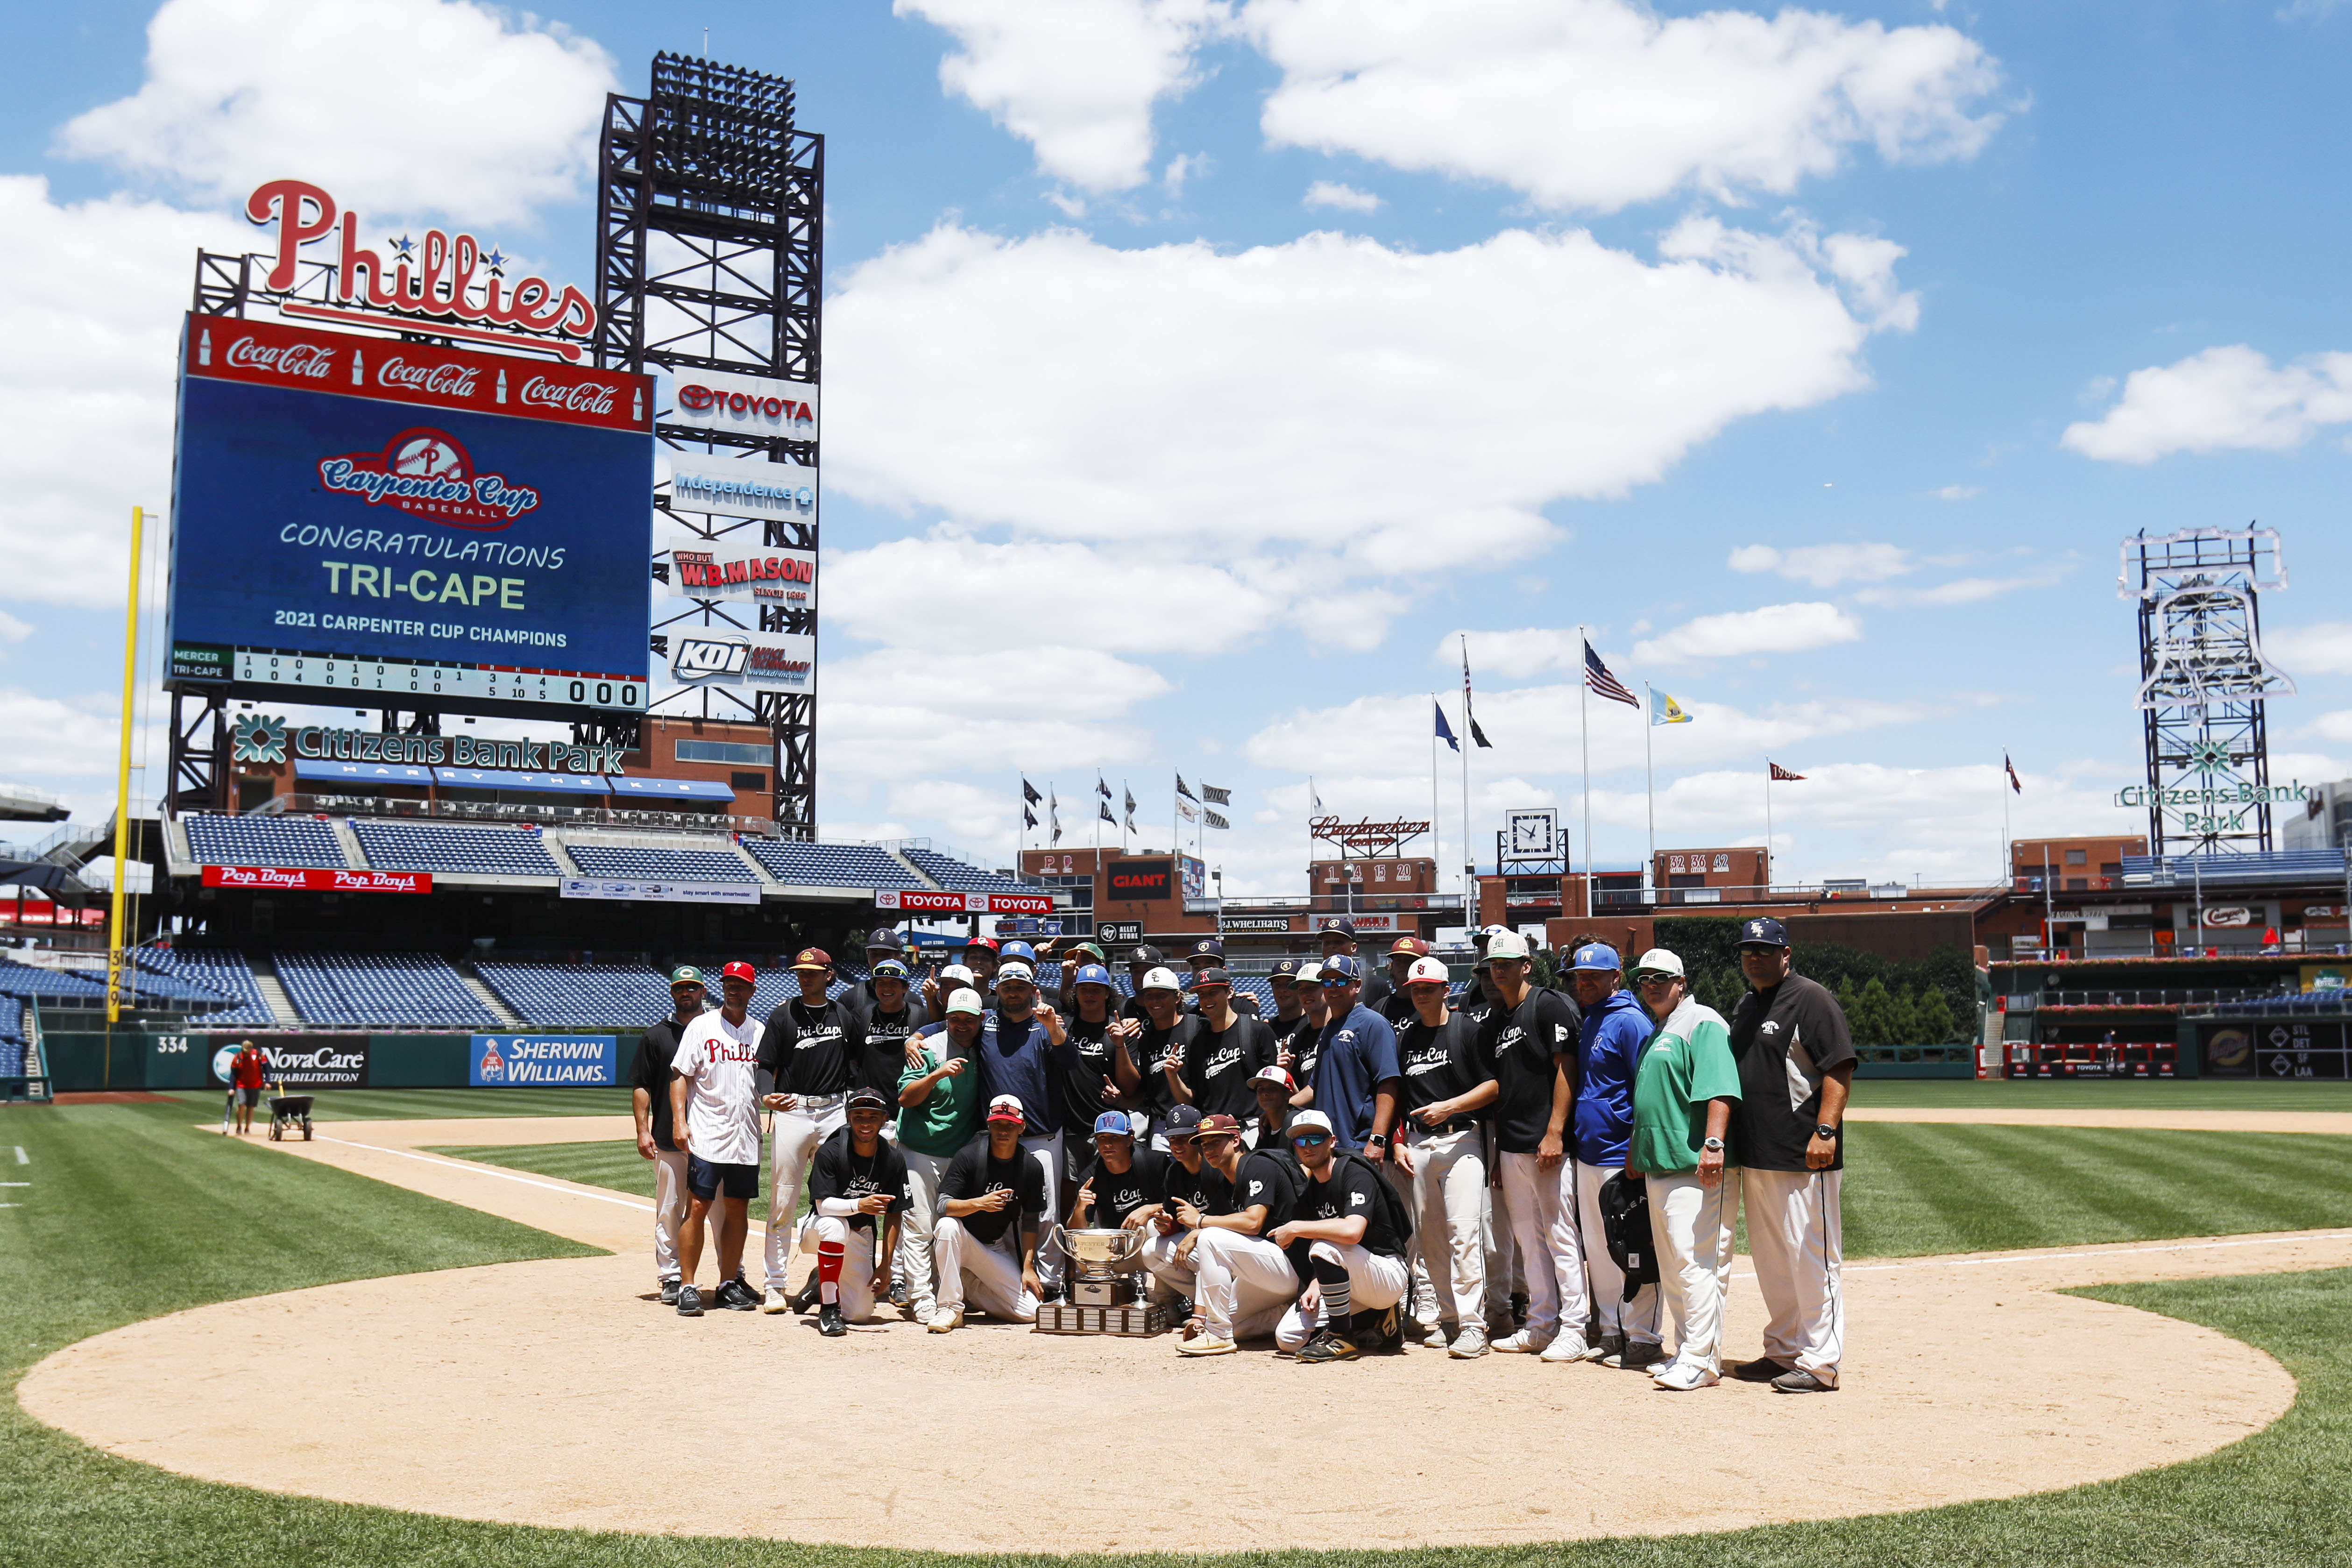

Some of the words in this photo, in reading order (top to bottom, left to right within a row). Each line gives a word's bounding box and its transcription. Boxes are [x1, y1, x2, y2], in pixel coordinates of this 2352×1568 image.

[246, 178, 598, 337] Phillies
[714, 390, 813, 421] TOYOTA
[322, 459, 471, 502] Carpenter
[474, 476, 537, 516] Cup
[676, 473, 792, 499] Independence
[403, 501, 497, 518] BASEBALL
[280, 523, 566, 569] CONGRATULATIONS
[676, 552, 695, 561] WHO
[696, 553, 712, 562] BUT
[323, 561, 525, 610] TRI-CAPE
[754, 587, 784, 598] SINCE
[787, 590, 807, 600] 1898
[275, 610, 317, 628] 2021
[322, 613, 425, 636] CARPENTER
[431, 623, 464, 639] CUP
[470, 627, 567, 647] CHAMPIONS
[753, 646, 785, 660] OFFICE
[174, 650, 219, 662] MERCER
[245, 656, 252, 666] 1
[271, 658, 278, 667] 0
[296, 660, 303, 669] 0
[327, 662, 334, 671] 0
[353, 664, 359, 673] 1
[377, 666, 384, 675] 0
[411, 668, 418, 677] 0
[434, 670, 441, 679] 0
[456, 671, 462, 681] 1
[489, 673, 496, 682] 3
[515, 675, 521, 684] 4
[539, 677, 545, 686] 4
[751, 658, 811, 673] TECHNOLOGY
[173, 665, 223, 677] TRI-CAPE
[244, 669, 252, 679] 0
[271, 671, 278, 681] 0
[295, 673, 302, 682] 4
[327, 675, 334, 685] 0
[352, 677, 359, 687] 0
[376, 679, 383, 688] 1
[411, 681, 418, 690] 0
[434, 683, 441, 692] 0
[489, 687, 496, 696] 5
[512, 688, 525, 698] 10
[539, 690, 546, 700] 5
[569, 681, 585, 702] 0
[596, 682, 612, 704] 0
[622, 684, 637, 706] 0
[296, 726, 446, 765] Citizens
[453, 735, 543, 769] Bank
[549, 738, 625, 774] Park
[1204, 787, 1224, 801] 2010
[2119, 786, 2230, 807] Citizens
[2237, 779, 2309, 803] Bank
[1205, 810, 1226, 828] 2011
[2184, 810, 2244, 833] Park
[1309, 816, 1430, 839] Budweiser
[1670, 856, 1684, 868] 32
[1691, 855, 1706, 867] 36
[1713, 854, 1728, 867] 42
[221, 867, 257, 884] Pep
[261, 869, 306, 887] Boys
[1329, 866, 1334, 879] 1
[1374, 865, 1386, 878] 15
[1397, 864, 1411, 877] 20
[334, 871, 369, 887] Pep
[373, 873, 415, 891] Boys
[1113, 874, 1165, 887] GIANT
[904, 895, 962, 908] TOYOTA
[992, 899, 1048, 910] TOYOTA
[1010, 944, 1021, 952] W
[1580, 950, 1594, 962] W
[679, 968, 694, 979] C
[733, 962, 742, 972] P
[950, 968, 962, 979] H
[1086, 968, 1098, 978] W
[1199, 971, 1210, 983] K
[2293, 1025, 2310, 1035] STL
[157, 1036, 188, 1054] 334
[510, 1038, 604, 1059] SHERWIN
[2293, 1038, 2310, 1048] DET
[261, 1047, 363, 1069] NovaCare
[704, 1039, 759, 1063] Philli
[2297, 1053, 2307, 1064] SF
[2295, 1067, 2312, 1077] LAA
[1102, 1115, 1116, 1127] W
[1301, 1114, 1312, 1124] H
